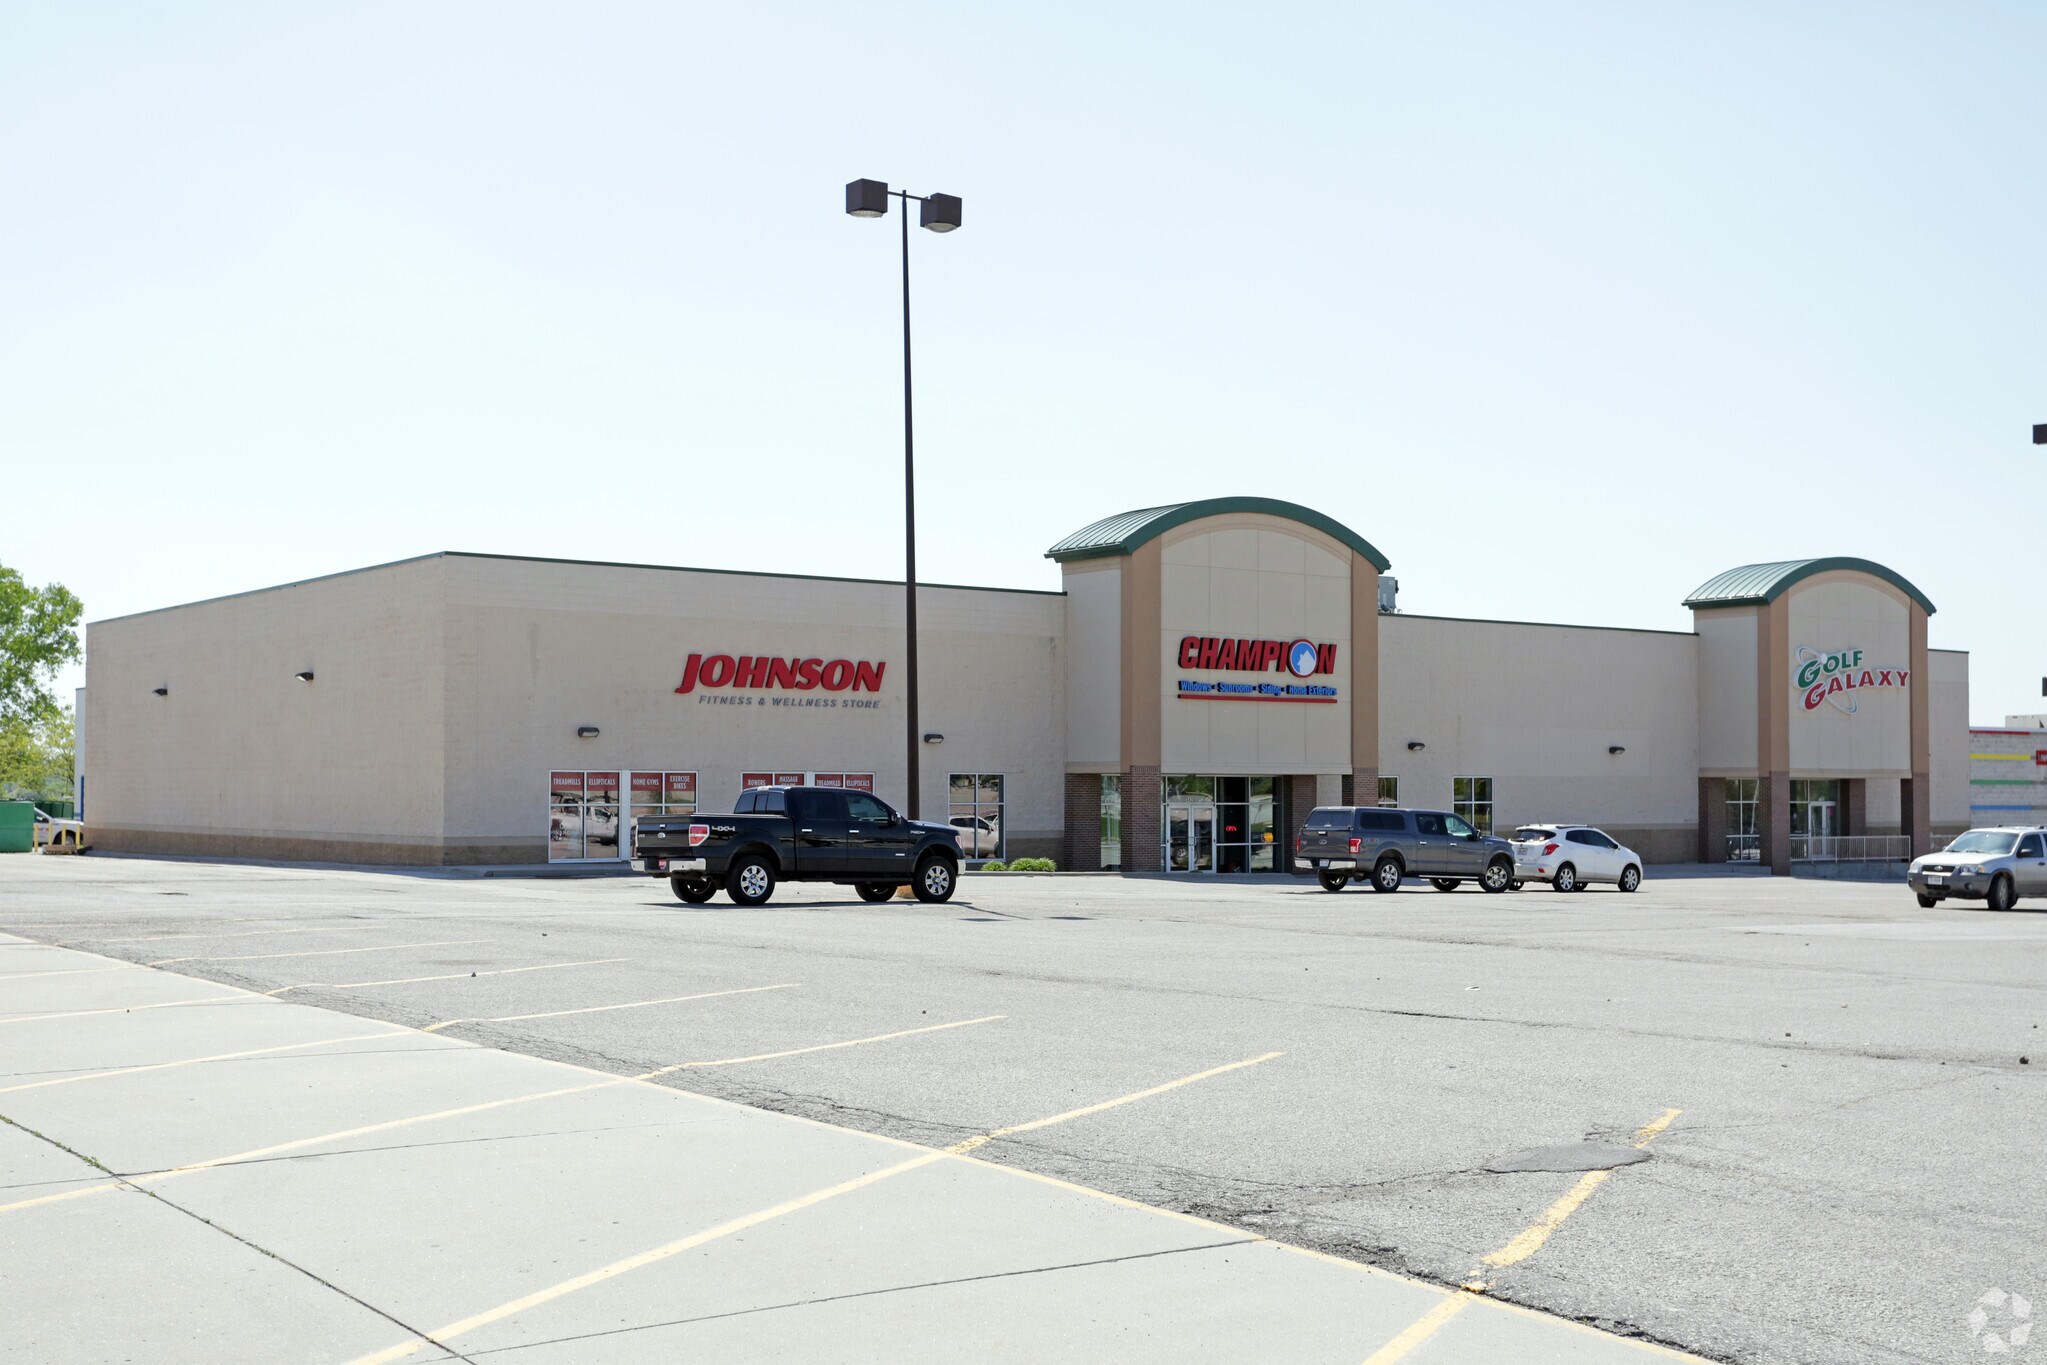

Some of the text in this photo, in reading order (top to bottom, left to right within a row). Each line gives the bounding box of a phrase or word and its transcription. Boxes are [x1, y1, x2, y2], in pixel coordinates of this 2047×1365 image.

[1178, 636, 1337, 678] CHAMPION
[674, 653, 886, 694] JOHNSON
[1798, 651, 1863, 688] GOLF
[1178, 680, 1337, 696] Windows Sunrooms Siding Home Exteriors
[1805, 671, 1909, 710] GALAXY
[699, 695, 880, 709] FITNESS & WELLNESS STORE
[553, 778, 581, 786] TREADMILLS
[588, 778, 616, 786] ELLIPTICALS
[633, 778, 659, 786] HOME GYMS
[670, 775, 690, 783] EXERCISE
